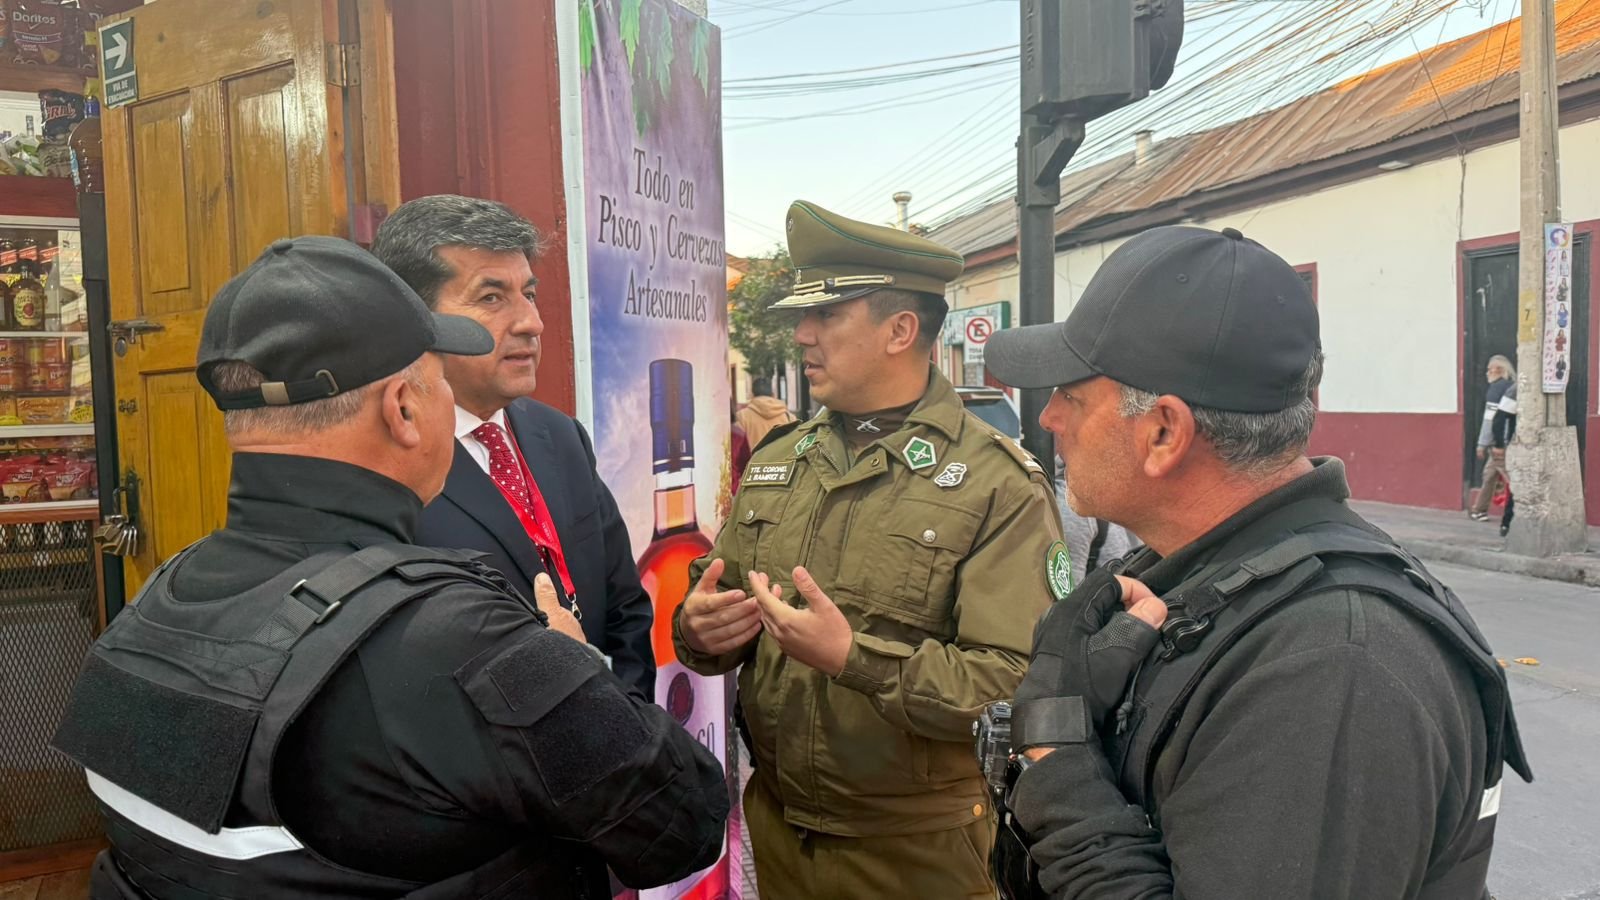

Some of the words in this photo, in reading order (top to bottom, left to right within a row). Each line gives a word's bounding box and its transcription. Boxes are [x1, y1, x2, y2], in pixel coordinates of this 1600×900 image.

[12, 11, 56, 24] Doritos
[121, 79, 128, 89] DE
[633, 148, 670, 204] Todo
[679, 179, 694, 210] en
[598, 194, 641, 252] Pisco
[649, 223, 659, 270] y
[667, 214, 723, 268] Cervezas
[624, 268, 707, 323] Artesanales
[1524, 309, 1531, 321] 7
[974, 323, 985, 337] E
